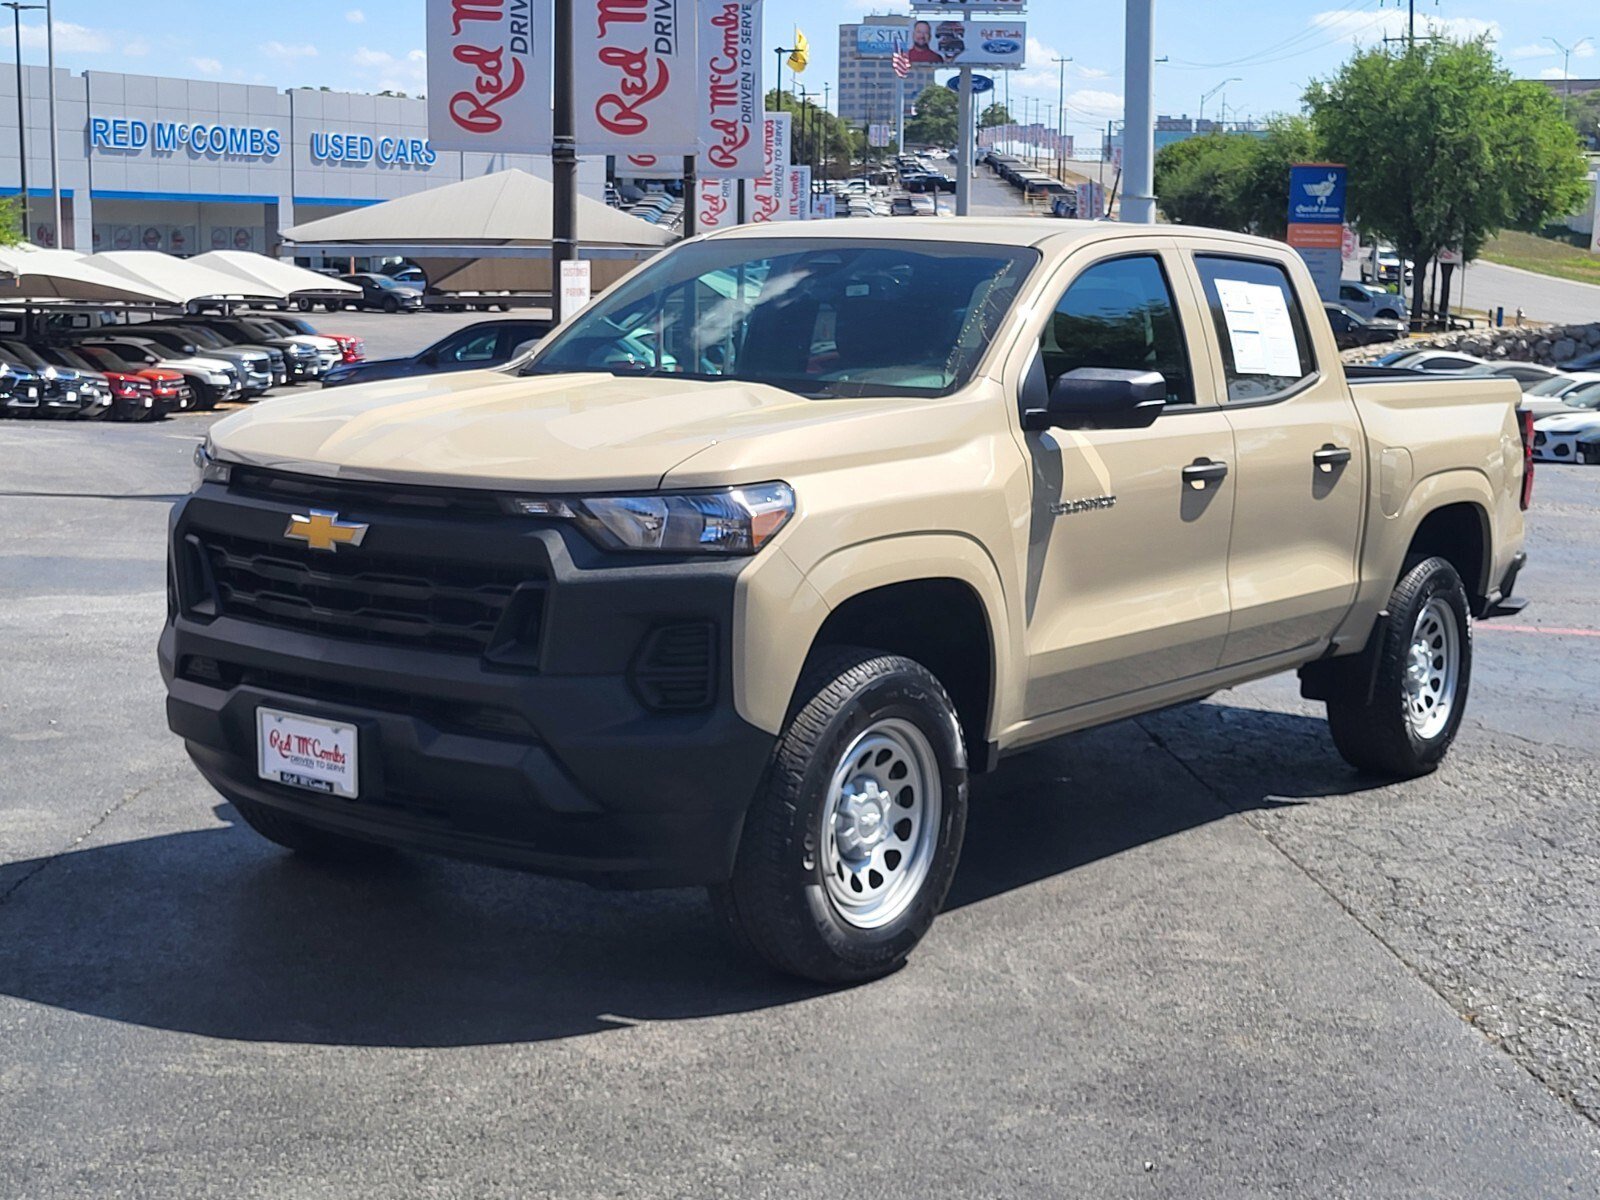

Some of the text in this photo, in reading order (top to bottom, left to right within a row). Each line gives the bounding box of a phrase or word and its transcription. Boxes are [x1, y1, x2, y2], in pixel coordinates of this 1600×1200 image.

[709, 3, 739, 115] McCombs
[741, 3, 753, 124] DRIVEN TO SERVE
[449, 44, 525, 134] Red
[595, 46, 670, 136] Red
[92, 118, 148, 149] RED
[313, 132, 437, 165] USED CARS
[708, 119, 750, 168] Red
[774, 120, 784, 198] DRIVEN TO SERVE
[700, 193, 728, 226] Red
[269, 729, 346, 765] Red McCombs
[290, 755, 346, 774] DRIVEN TO SERVE
